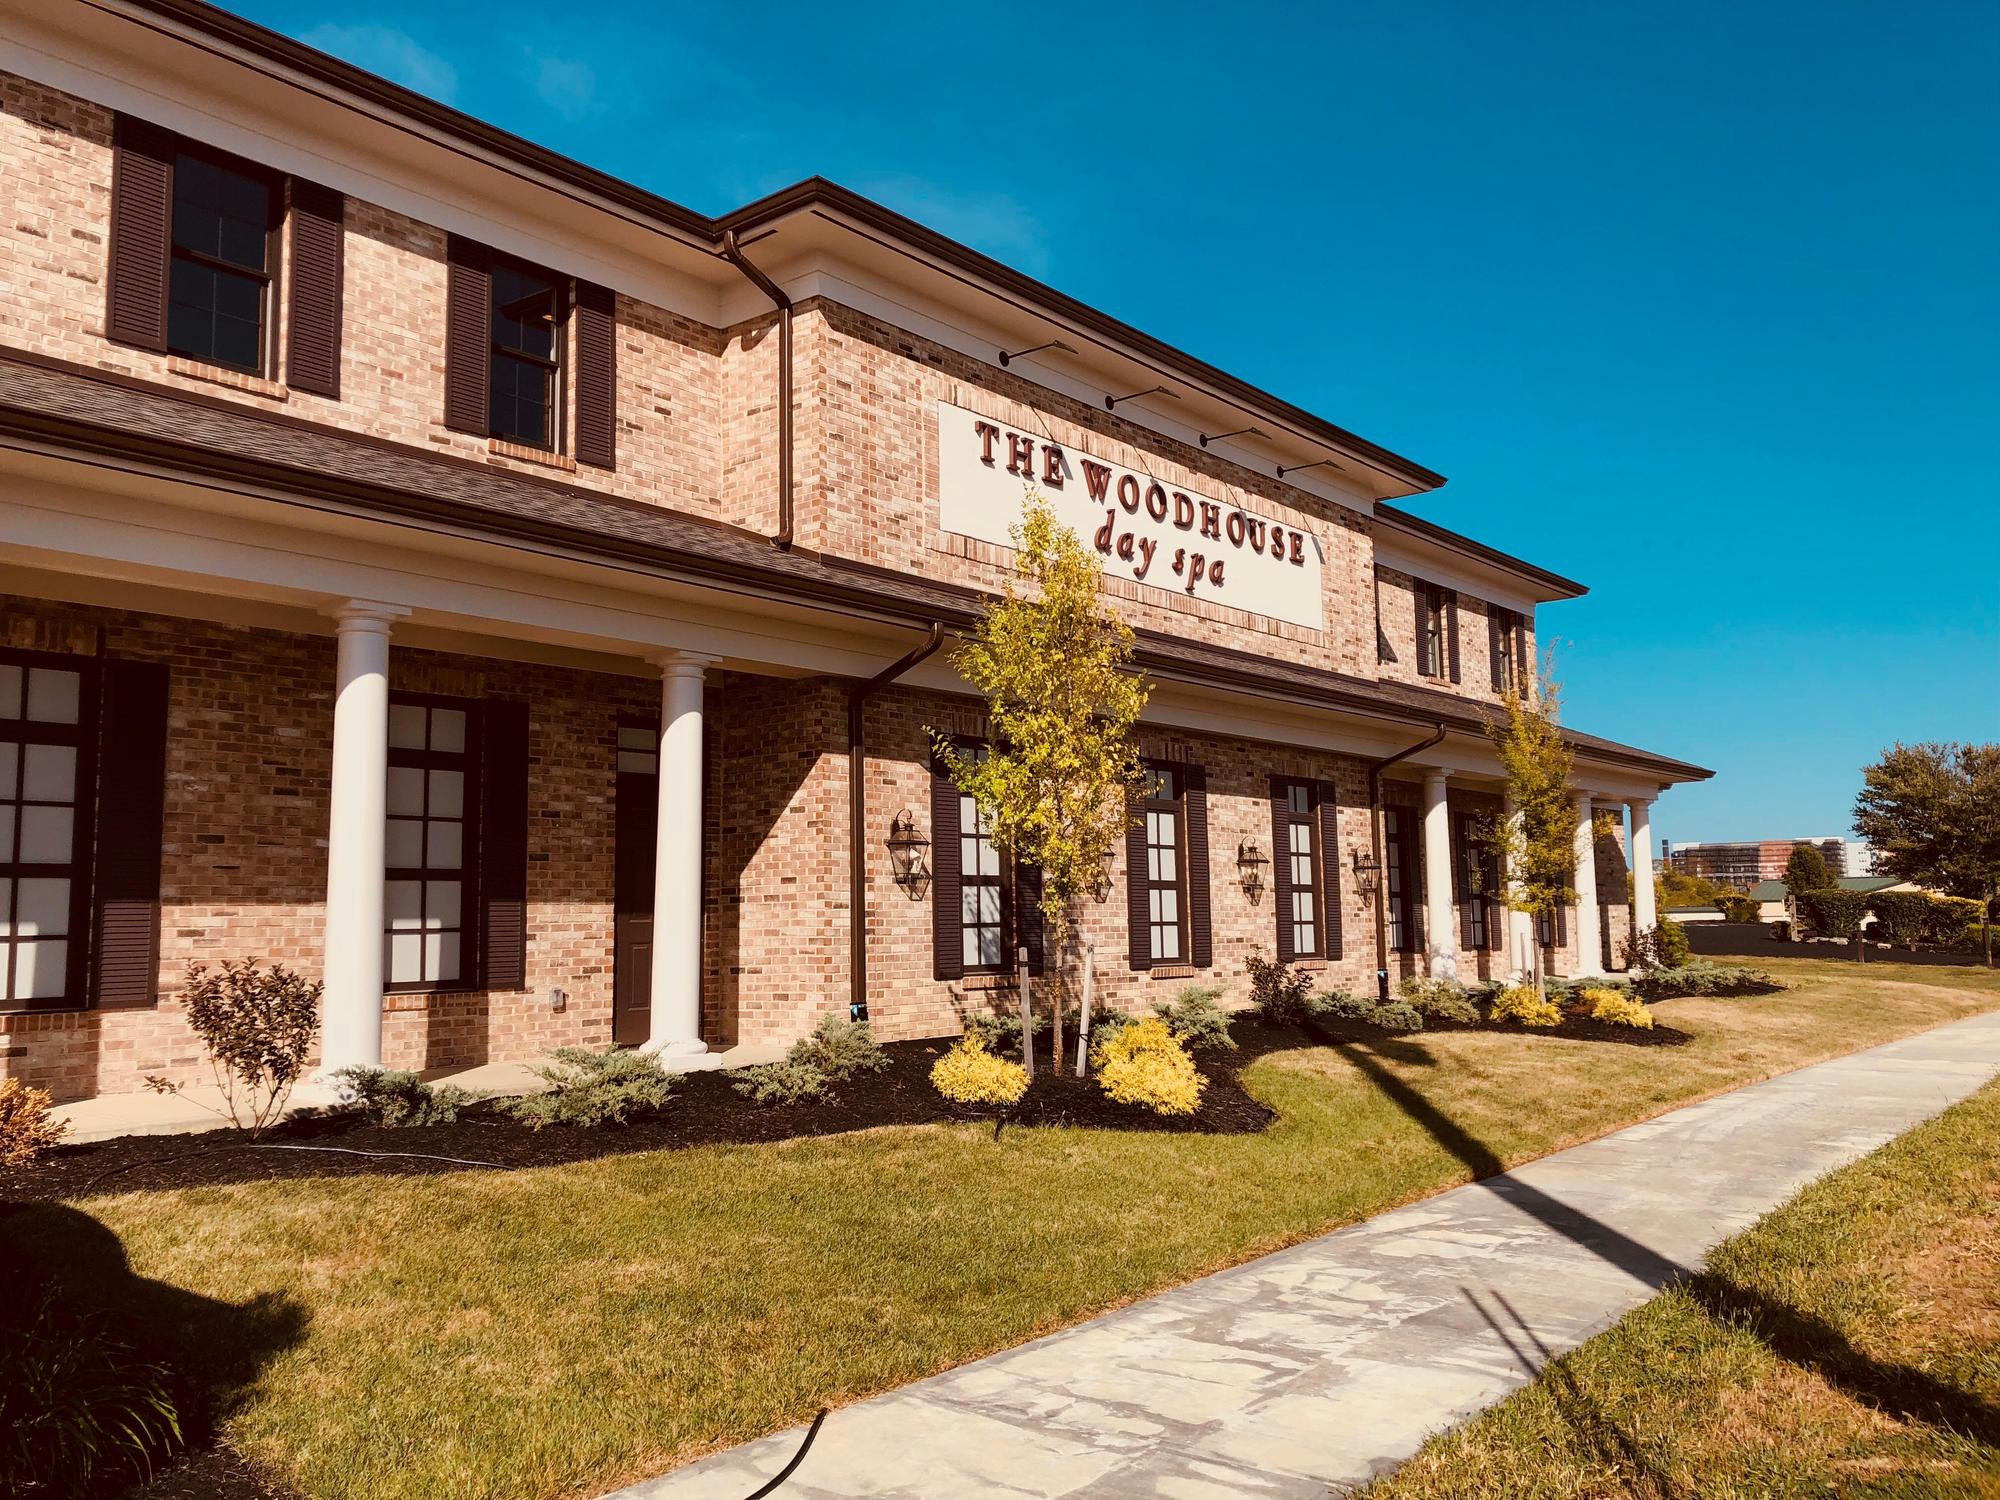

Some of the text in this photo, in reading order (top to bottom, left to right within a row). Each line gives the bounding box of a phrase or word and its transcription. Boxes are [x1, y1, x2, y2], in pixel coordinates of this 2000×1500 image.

[975, 420, 1305, 563] THE WOODHOUSE
[1094, 509, 1225, 591] day spa
